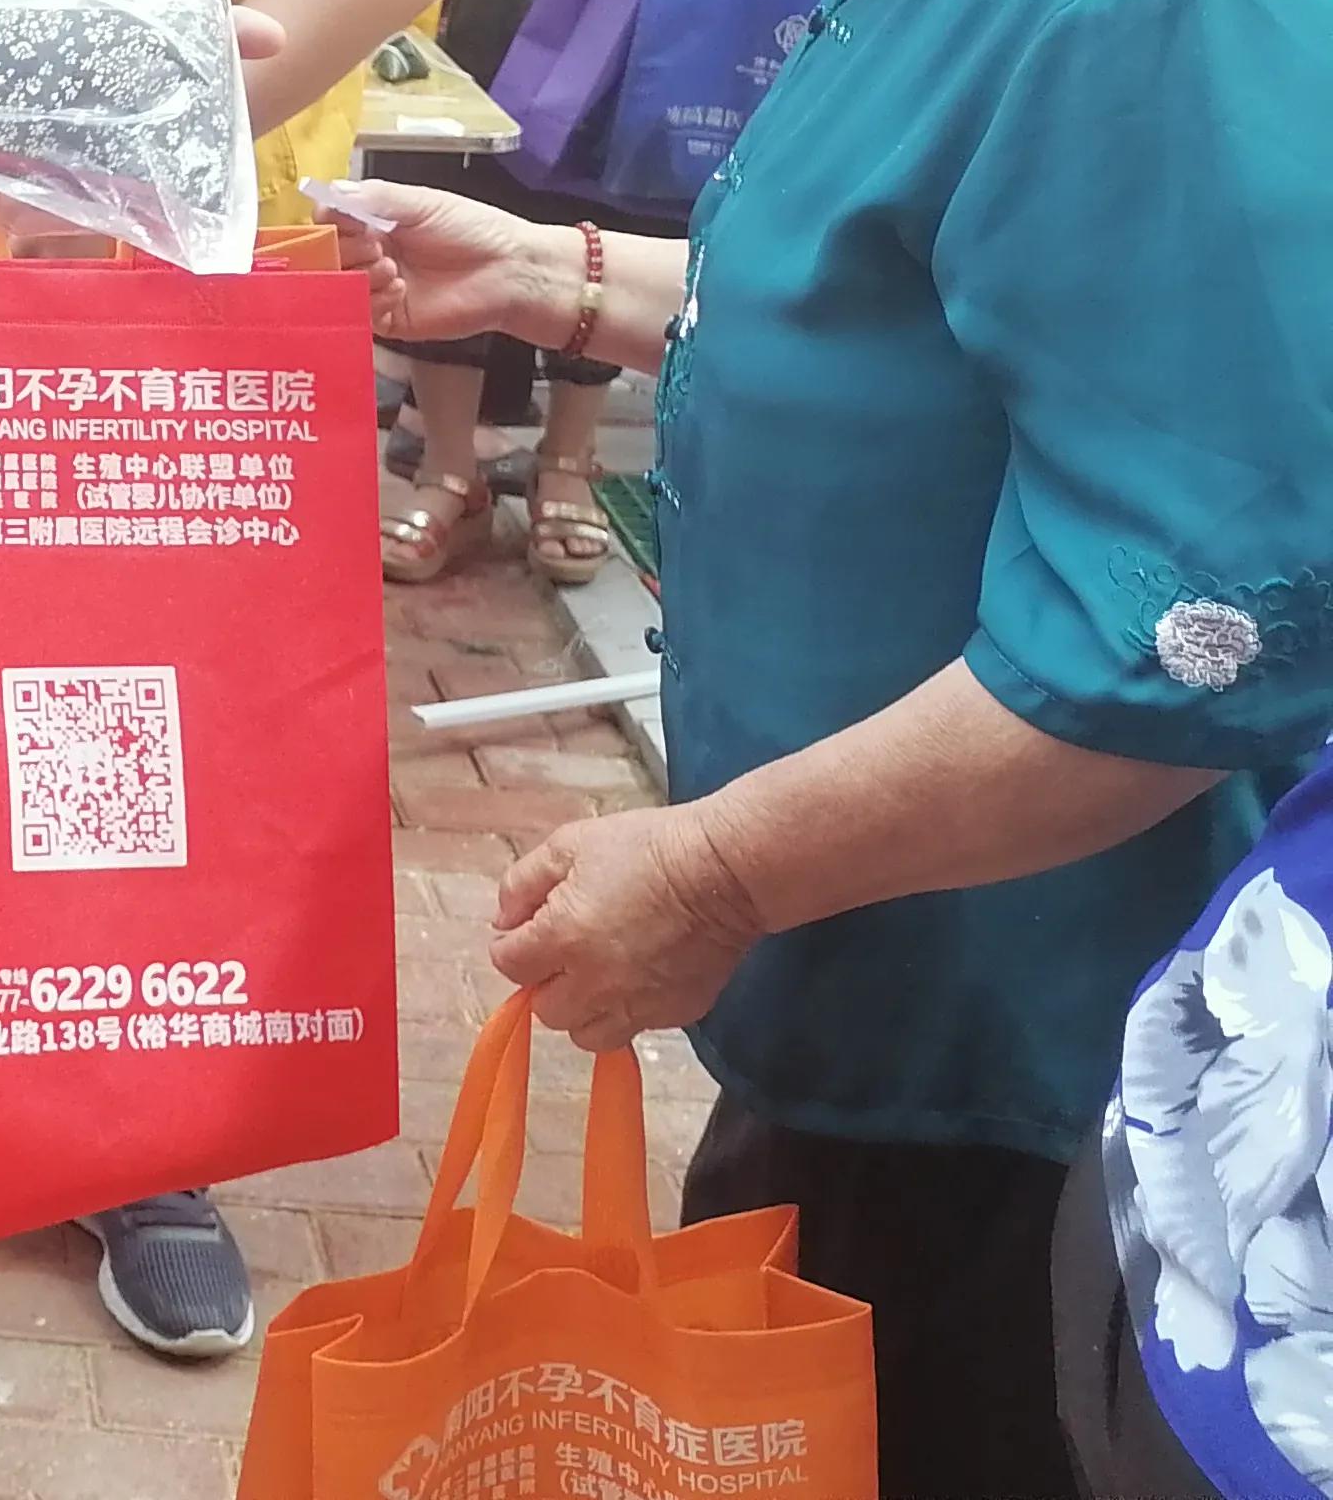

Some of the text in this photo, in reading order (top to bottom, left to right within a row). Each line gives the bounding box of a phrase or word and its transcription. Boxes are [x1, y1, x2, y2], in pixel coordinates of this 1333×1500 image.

[52, 417, 188, 442] INFERTILITY
[194, 418, 319, 442] HOSPITAL
[72, 452, 295, 480] 生殖中心联盟单位
[31, 964, 132, 1013] 6229
[141, 960, 249, 1006] 6622
[443, 1362, 808, 1466] 南阳不孕不育症医院
[533, 1409, 670, 1476] INFERTILITY
[678, 1463, 808, 1494] HOSPITAL
